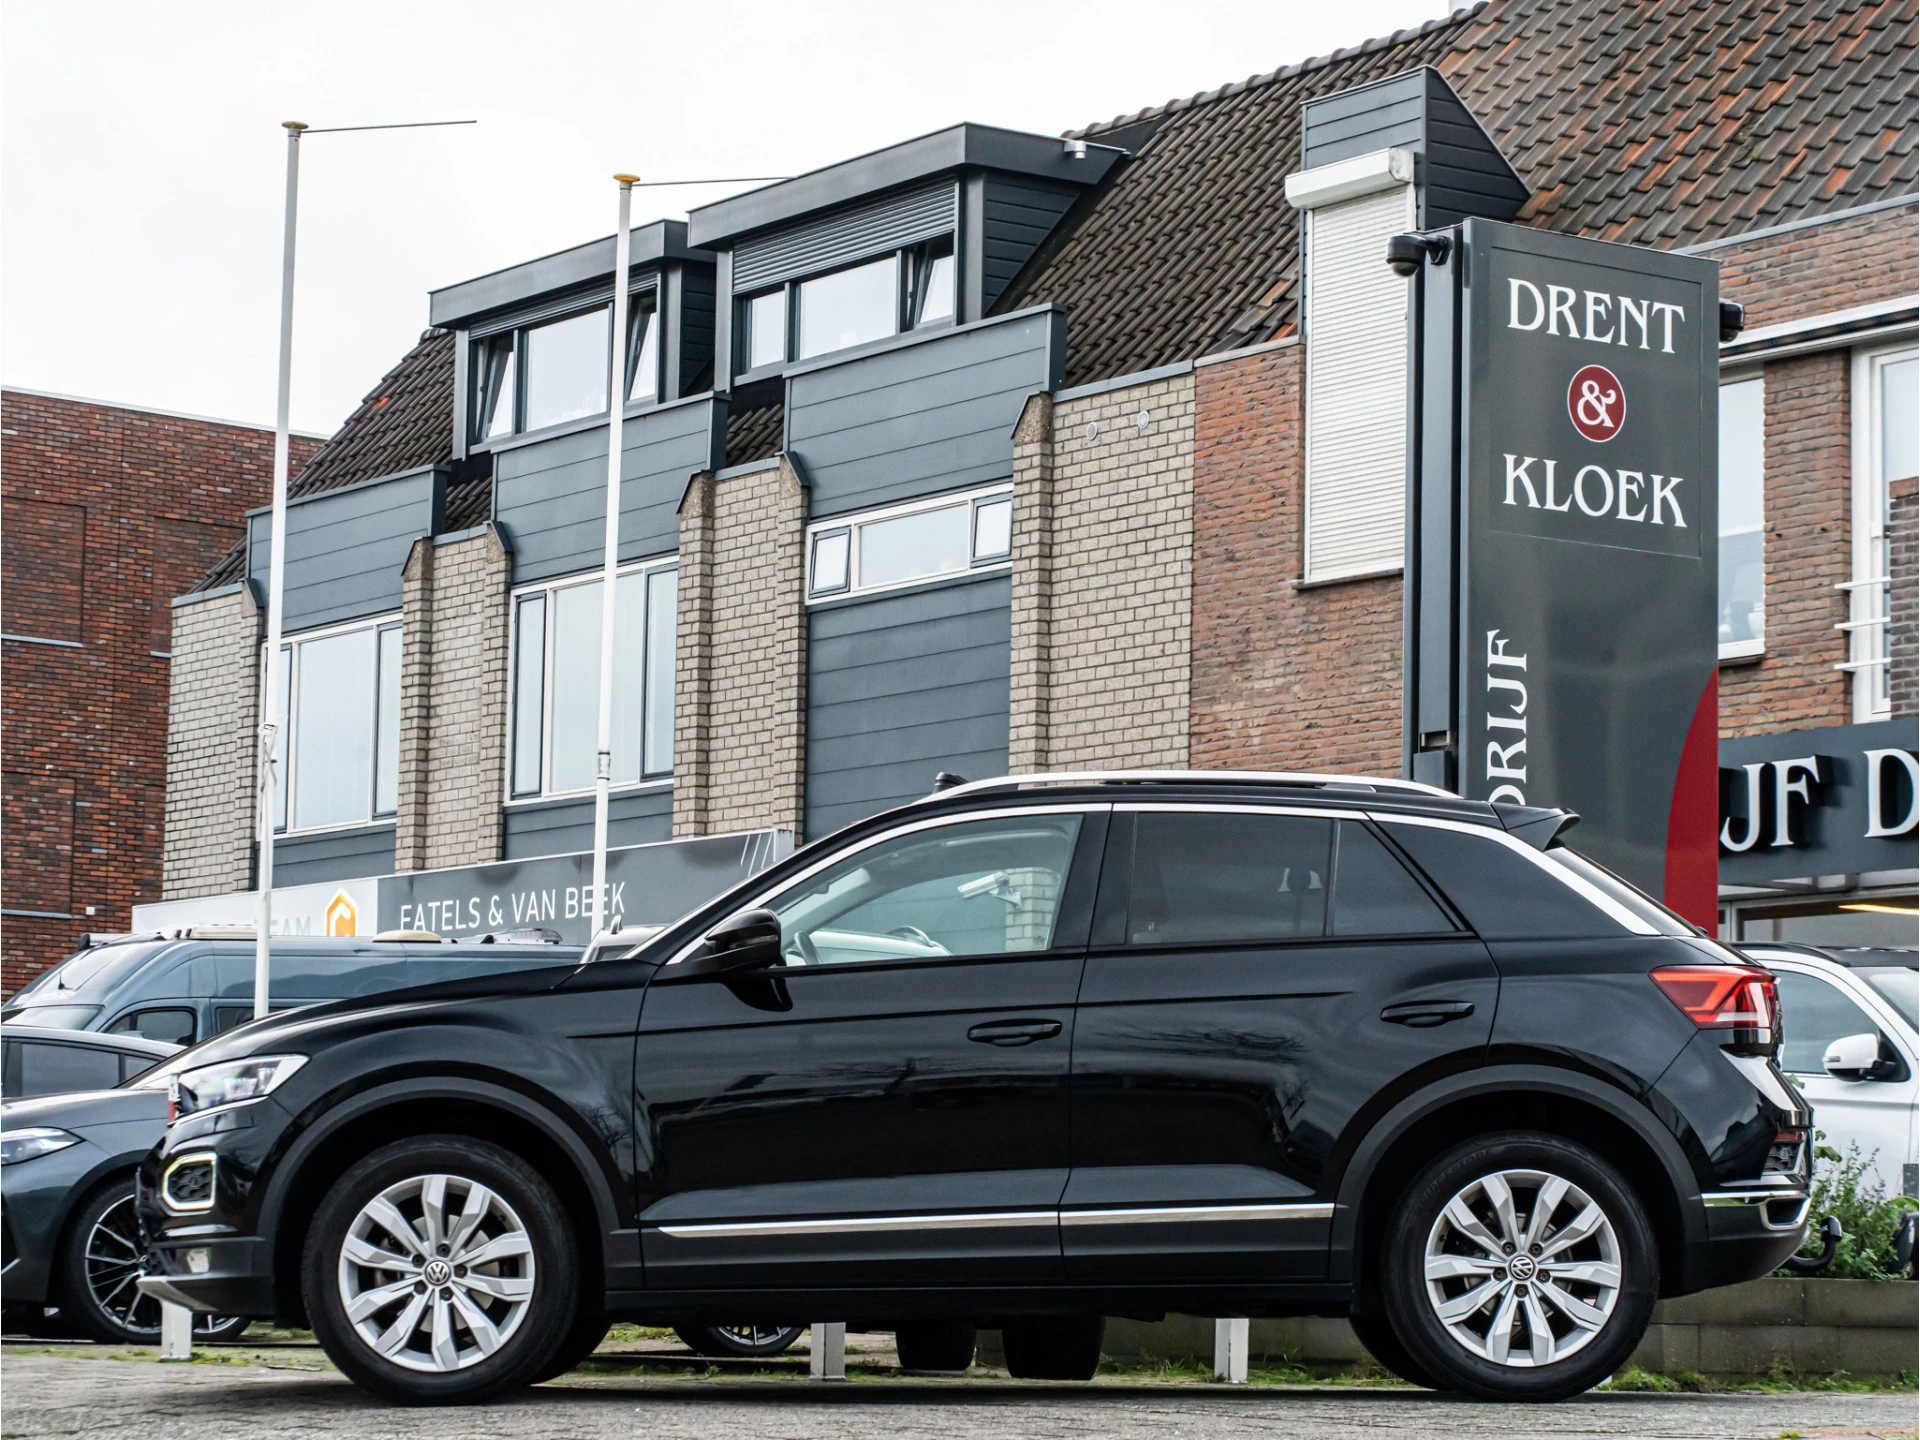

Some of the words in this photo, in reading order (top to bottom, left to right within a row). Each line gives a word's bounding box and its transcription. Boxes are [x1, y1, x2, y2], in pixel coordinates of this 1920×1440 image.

[1507, 277, 1686, 354] DRENT
[1576, 379, 1617, 428] &
[1502, 453, 1688, 528] KLOEK
[488, 894, 503, 927] &
[511, 889, 556, 924] VAN
